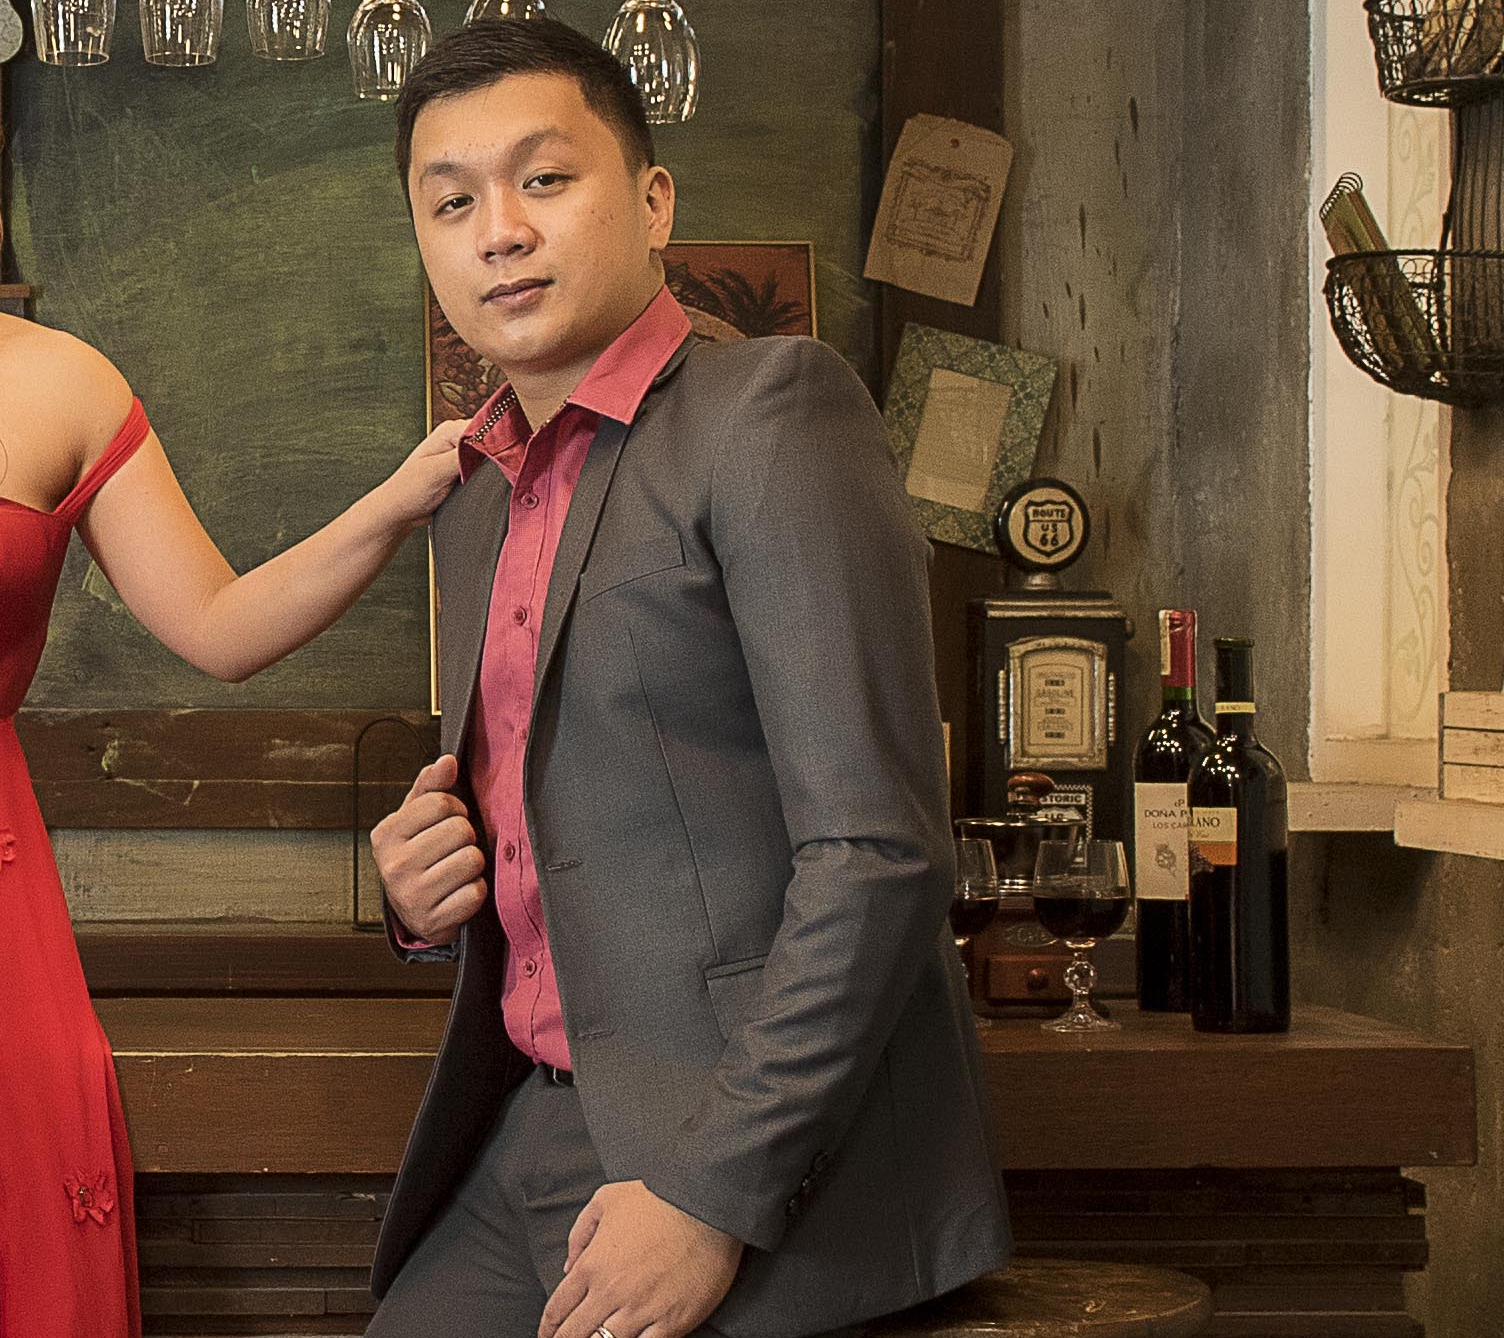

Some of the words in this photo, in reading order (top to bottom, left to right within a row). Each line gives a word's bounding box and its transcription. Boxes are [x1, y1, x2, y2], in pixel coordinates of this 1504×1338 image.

[1032, 508, 1066, 518] ROUTE
[1039, 533, 1059, 547] 66
[1042, 795, 1083, 803] STORIC
